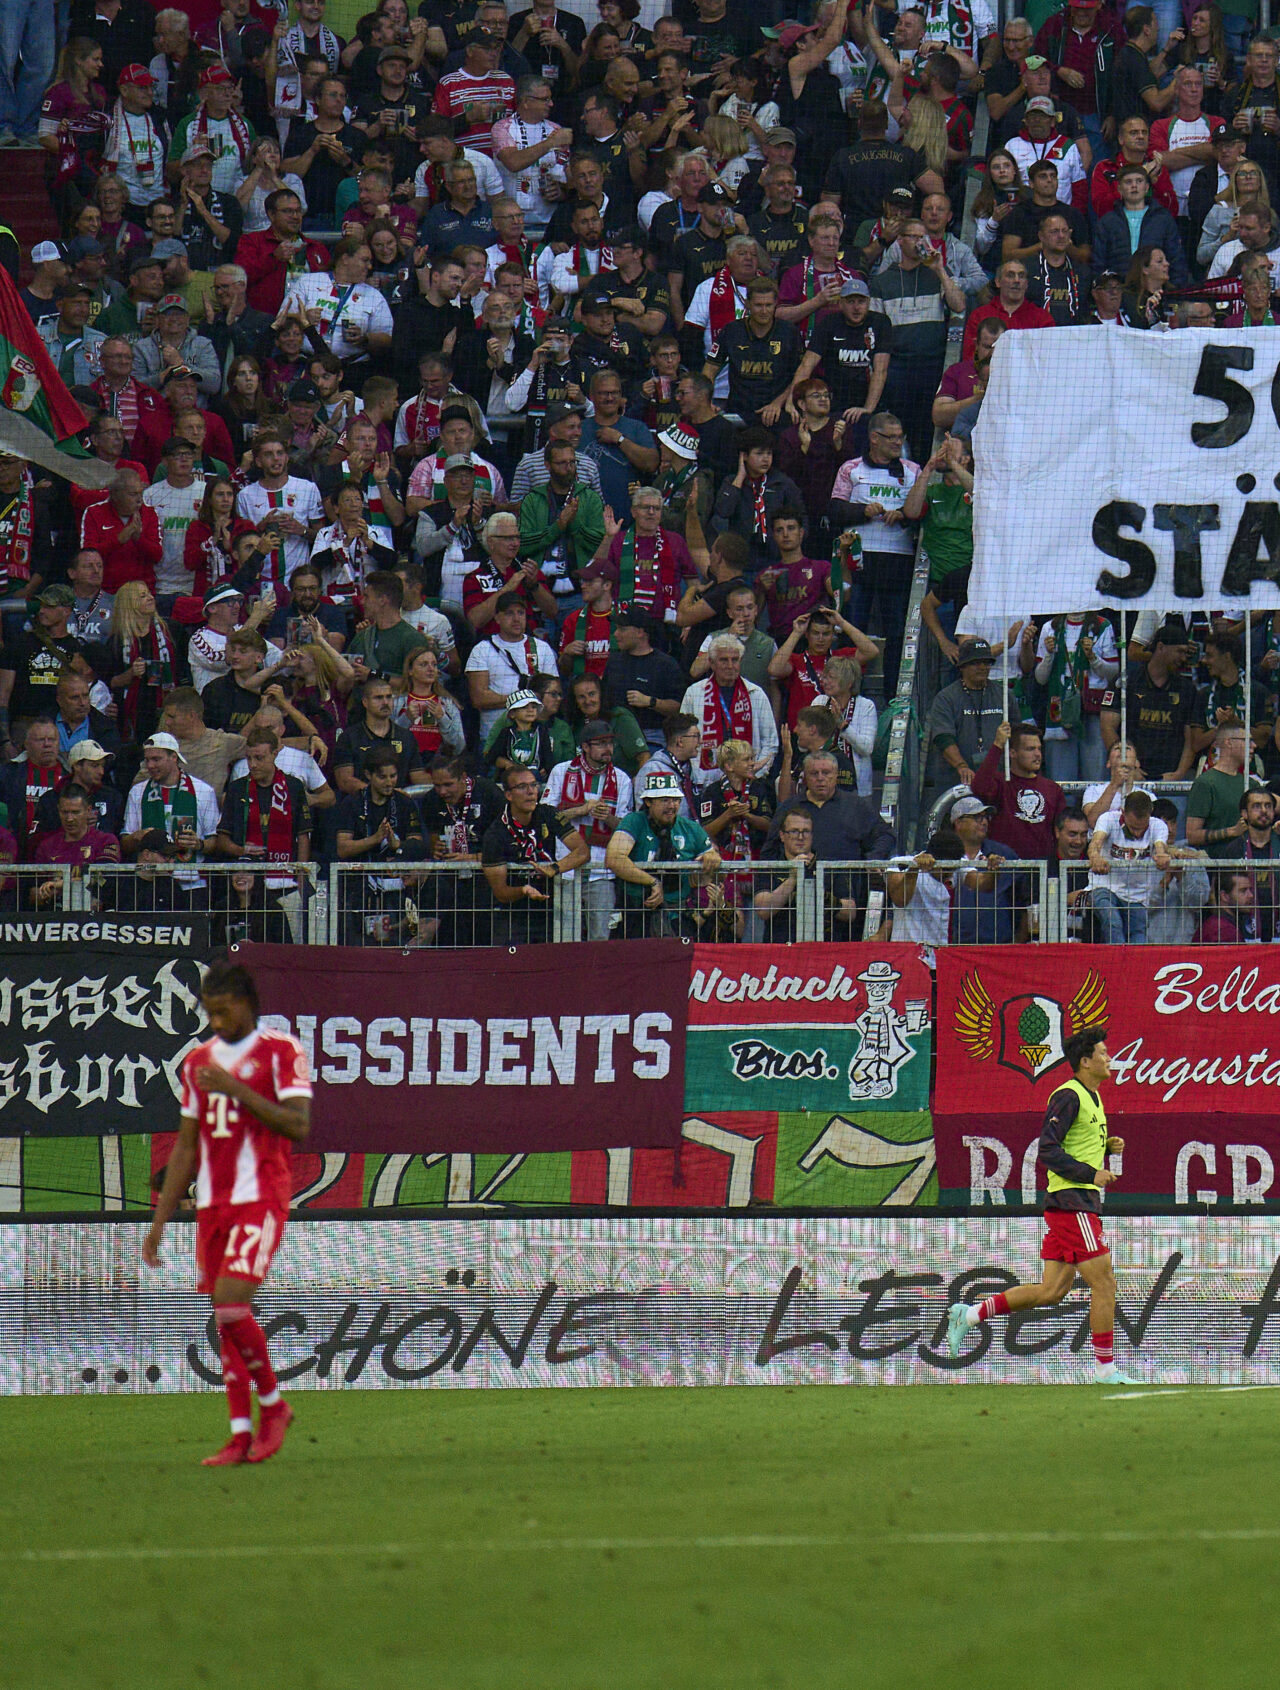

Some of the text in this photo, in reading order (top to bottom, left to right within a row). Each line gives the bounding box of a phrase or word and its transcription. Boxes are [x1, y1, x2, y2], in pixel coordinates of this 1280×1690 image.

[766, 239, 799, 252] WWK
[838, 348, 871, 363] WWK
[741, 360, 773, 375] WWK
[869, 485, 900, 498] WWK
[1139, 707, 1173, 725] WWK
[259, 1012, 673, 1086] ISSIDENTS
[729, 1039, 839, 1081] Bros.
[225, 1223, 263, 1258] 17
